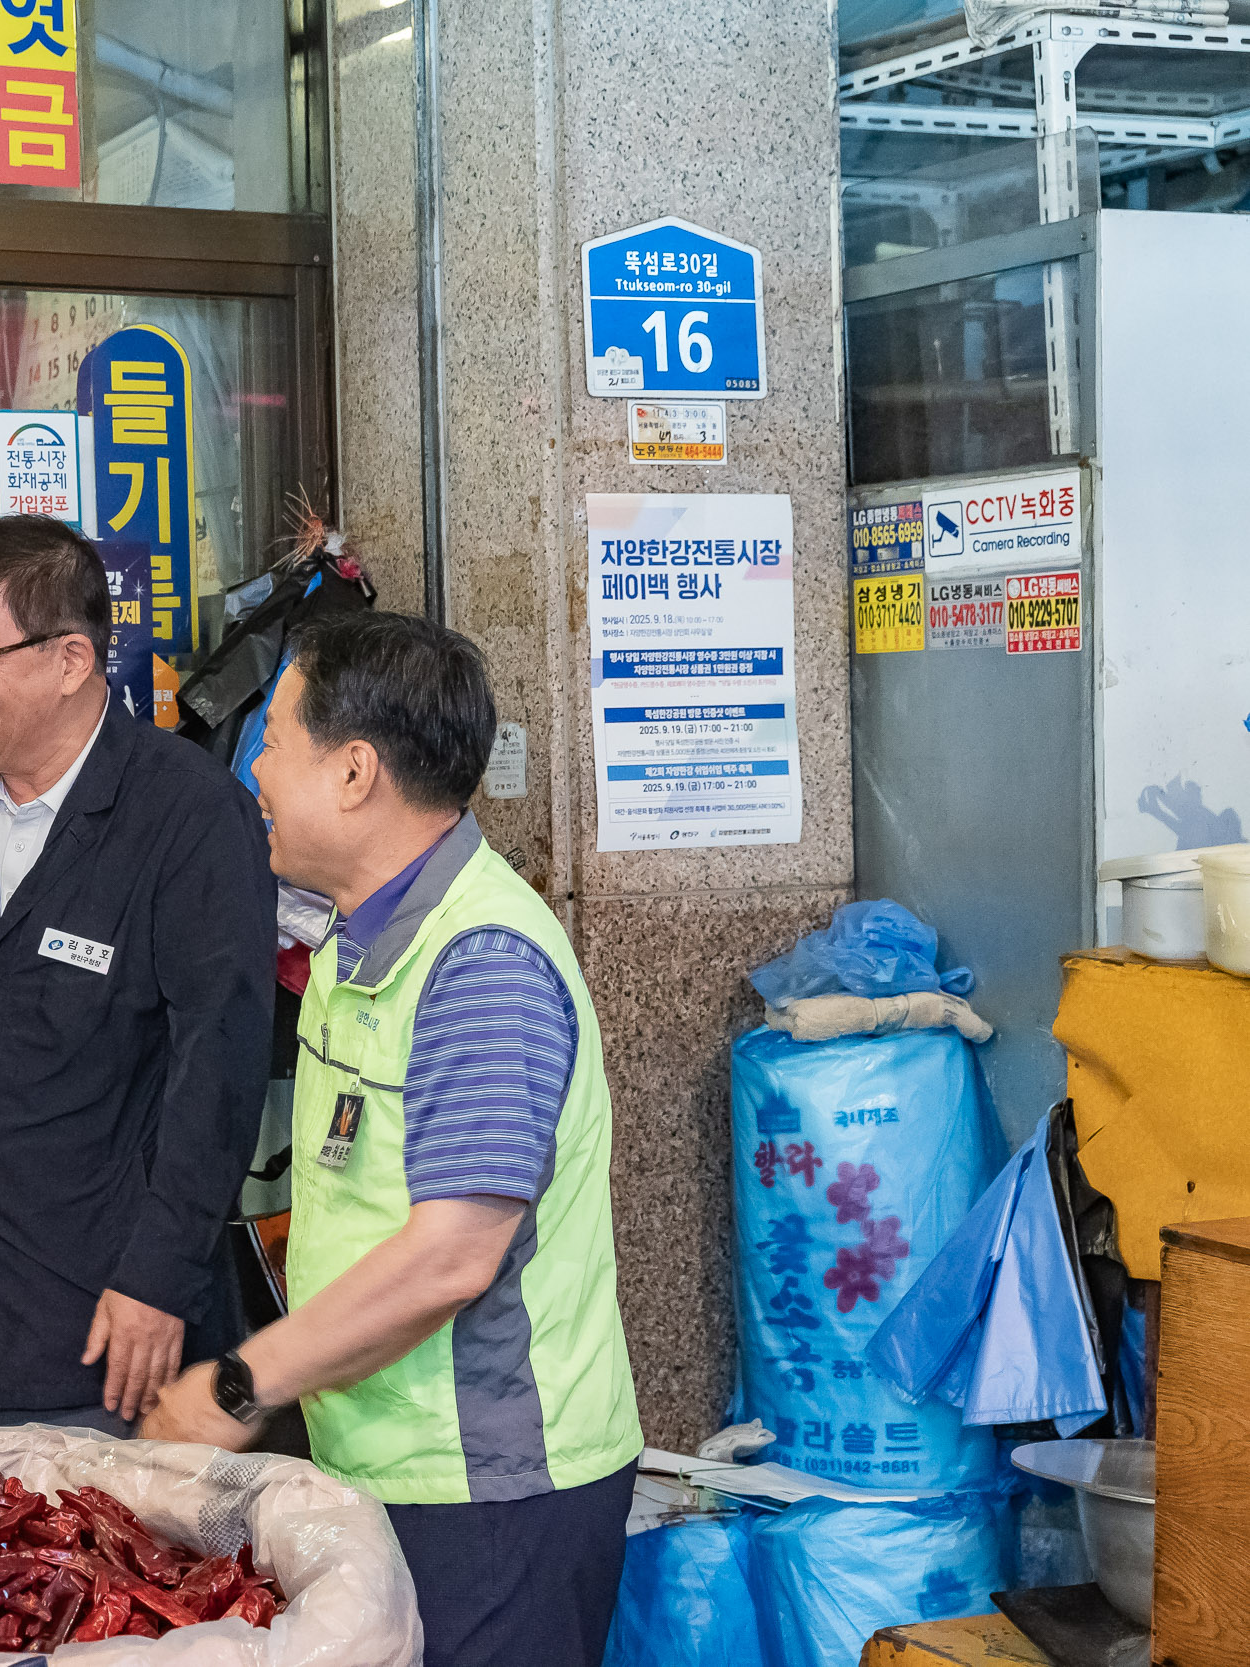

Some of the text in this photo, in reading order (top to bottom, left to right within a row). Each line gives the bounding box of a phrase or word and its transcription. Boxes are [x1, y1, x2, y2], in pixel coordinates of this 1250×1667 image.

[624, 250, 719, 277] 뚝섬로30길
[615, 278, 732, 296] Ttukseom-ro 30-gil
[51, 313, 59, 333] 8
[69, 305, 77, 326] 9
[85, 296, 96, 320] 10
[642, 310, 713, 373] 16
[48, 357, 60, 381] 15
[67, 350, 79, 374] 16
[726, 379, 758, 390] 05085
[638, 422, 665, 430] 서울특별시
[699, 430, 707, 443] 3
[7, 450, 66, 469] 전통시장
[8, 473, 67, 491] 화재공제
[10, 495, 69, 514] 가입점포
[966, 486, 1075, 525] CCTV 녹화중
[853, 520, 923, 548] 010-8565-6959
[973, 531, 1070, 553] Camera Recording
[601, 539, 782, 566] 자양한강전통시장
[602, 573, 722, 600] 페이백 행사
[858, 582, 921, 603] 삼성냉기
[931, 583, 1003, 602] LG냉동써비스
[930, 601, 1004, 628] 010-5478-3177
[1009, 597, 1079, 630] 010-9229-5707
[640, 651, 696, 662] 자양한강전통시장
[633, 664, 690, 675] 자양한강전통시장
[699, 723, 721, 732] 17:00
[730, 723, 754, 732] 21:00
[702, 781, 725, 790] 17:00
[734, 780, 757, 789] 21:00
[68, 939, 110, 960] 김경호
[70, 952, 102, 968] 광진구청장
